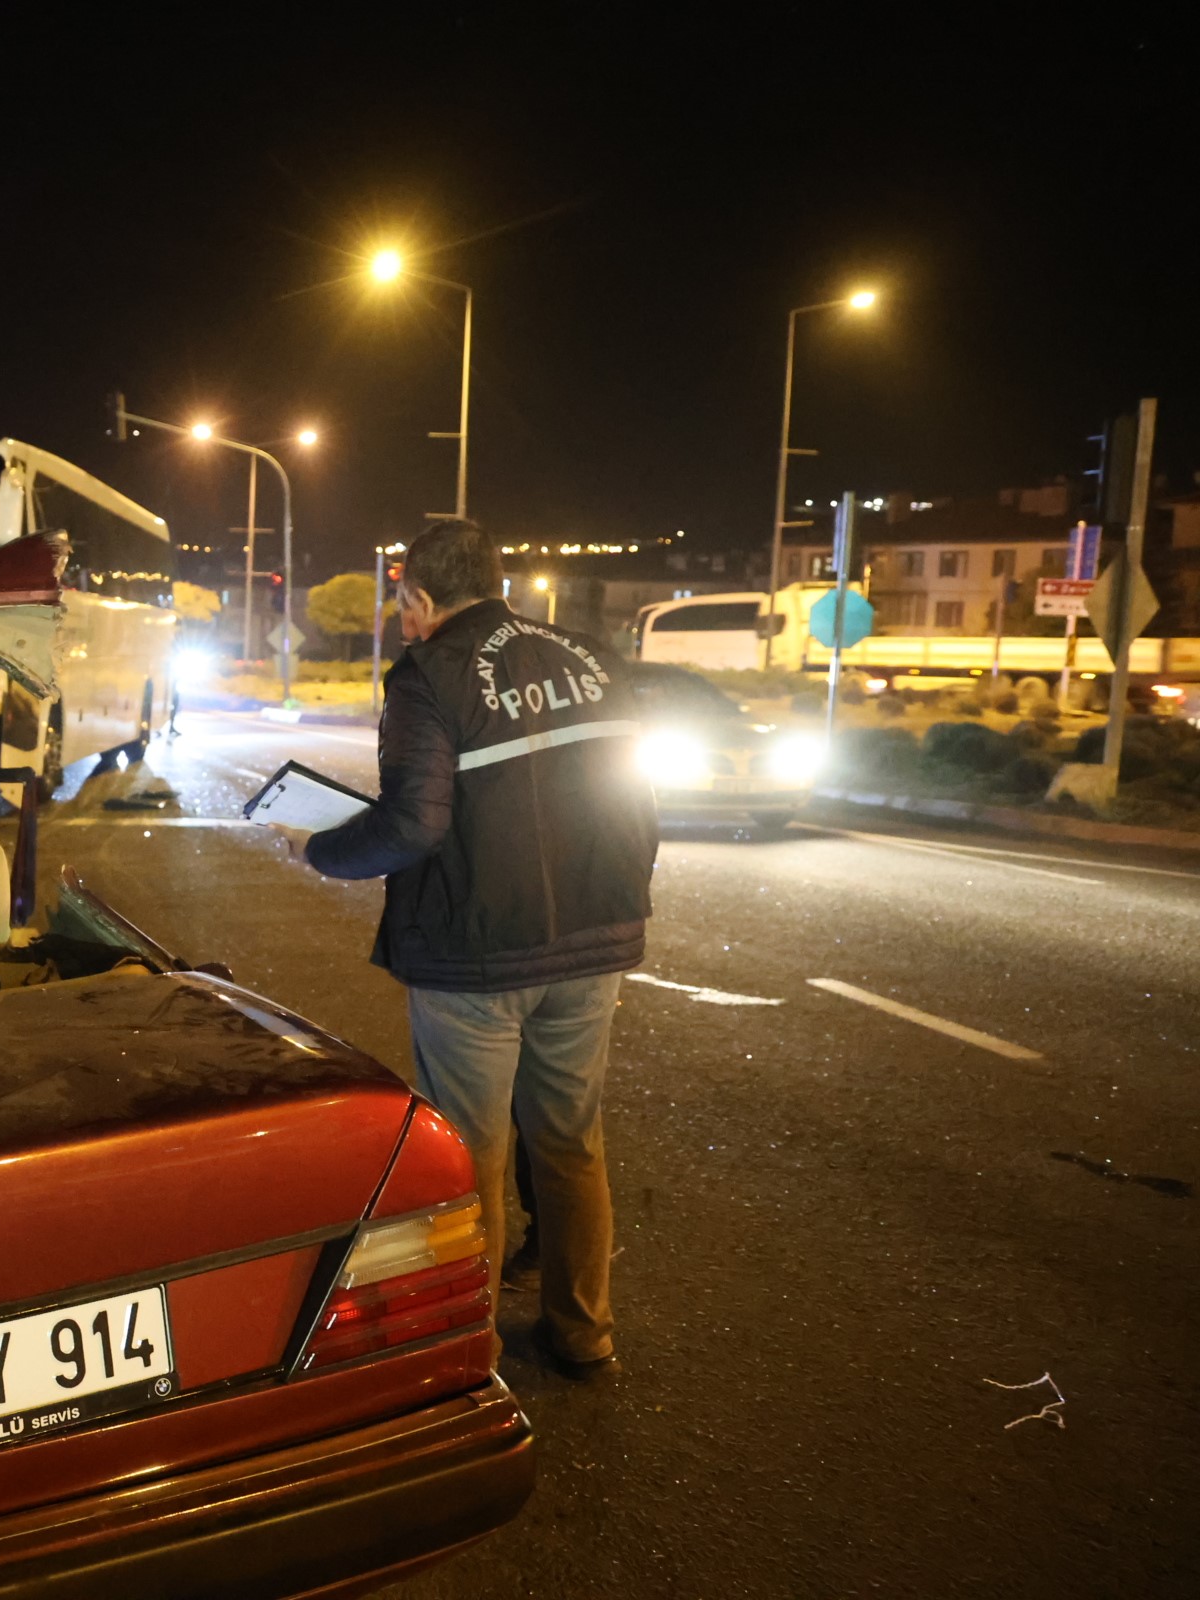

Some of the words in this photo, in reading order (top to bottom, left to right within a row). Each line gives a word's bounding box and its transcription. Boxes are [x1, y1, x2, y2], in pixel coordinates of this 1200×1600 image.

[481, 622, 519, 653] YERİ
[513, 620, 610, 684] İNCELEME
[477, 657, 500, 711] OLAY
[499, 667, 603, 720] POLİS
[50, 1302, 155, 1389] 914
[31, 1407, 80, 1429] SERVİS
